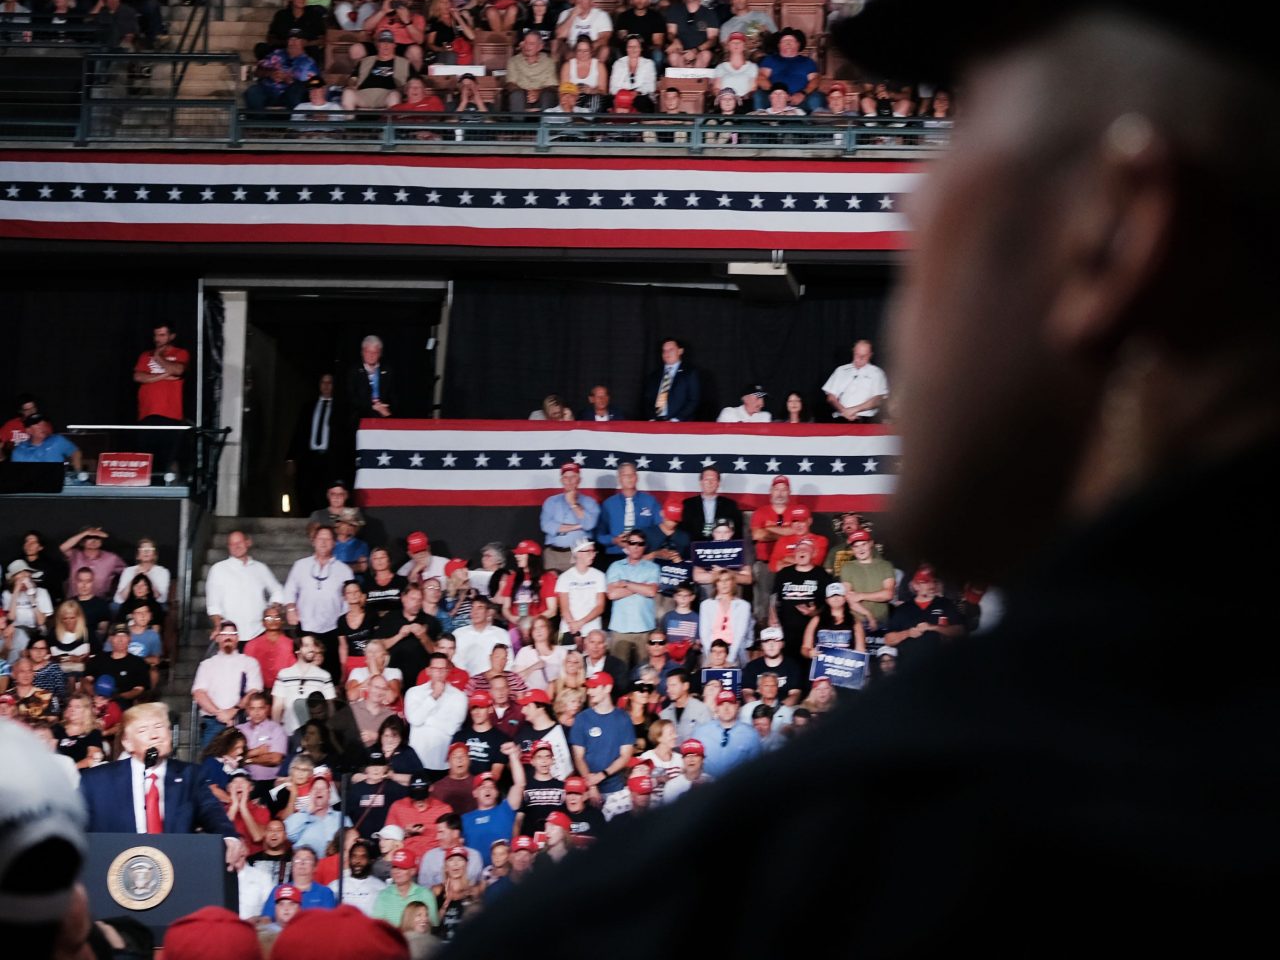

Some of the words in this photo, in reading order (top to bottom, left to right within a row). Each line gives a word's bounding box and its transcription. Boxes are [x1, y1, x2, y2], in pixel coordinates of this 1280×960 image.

[101, 460, 150, 468] TRUMP
[694, 547, 743, 556] TRUMP
[817, 653, 866, 669] TRUMP
